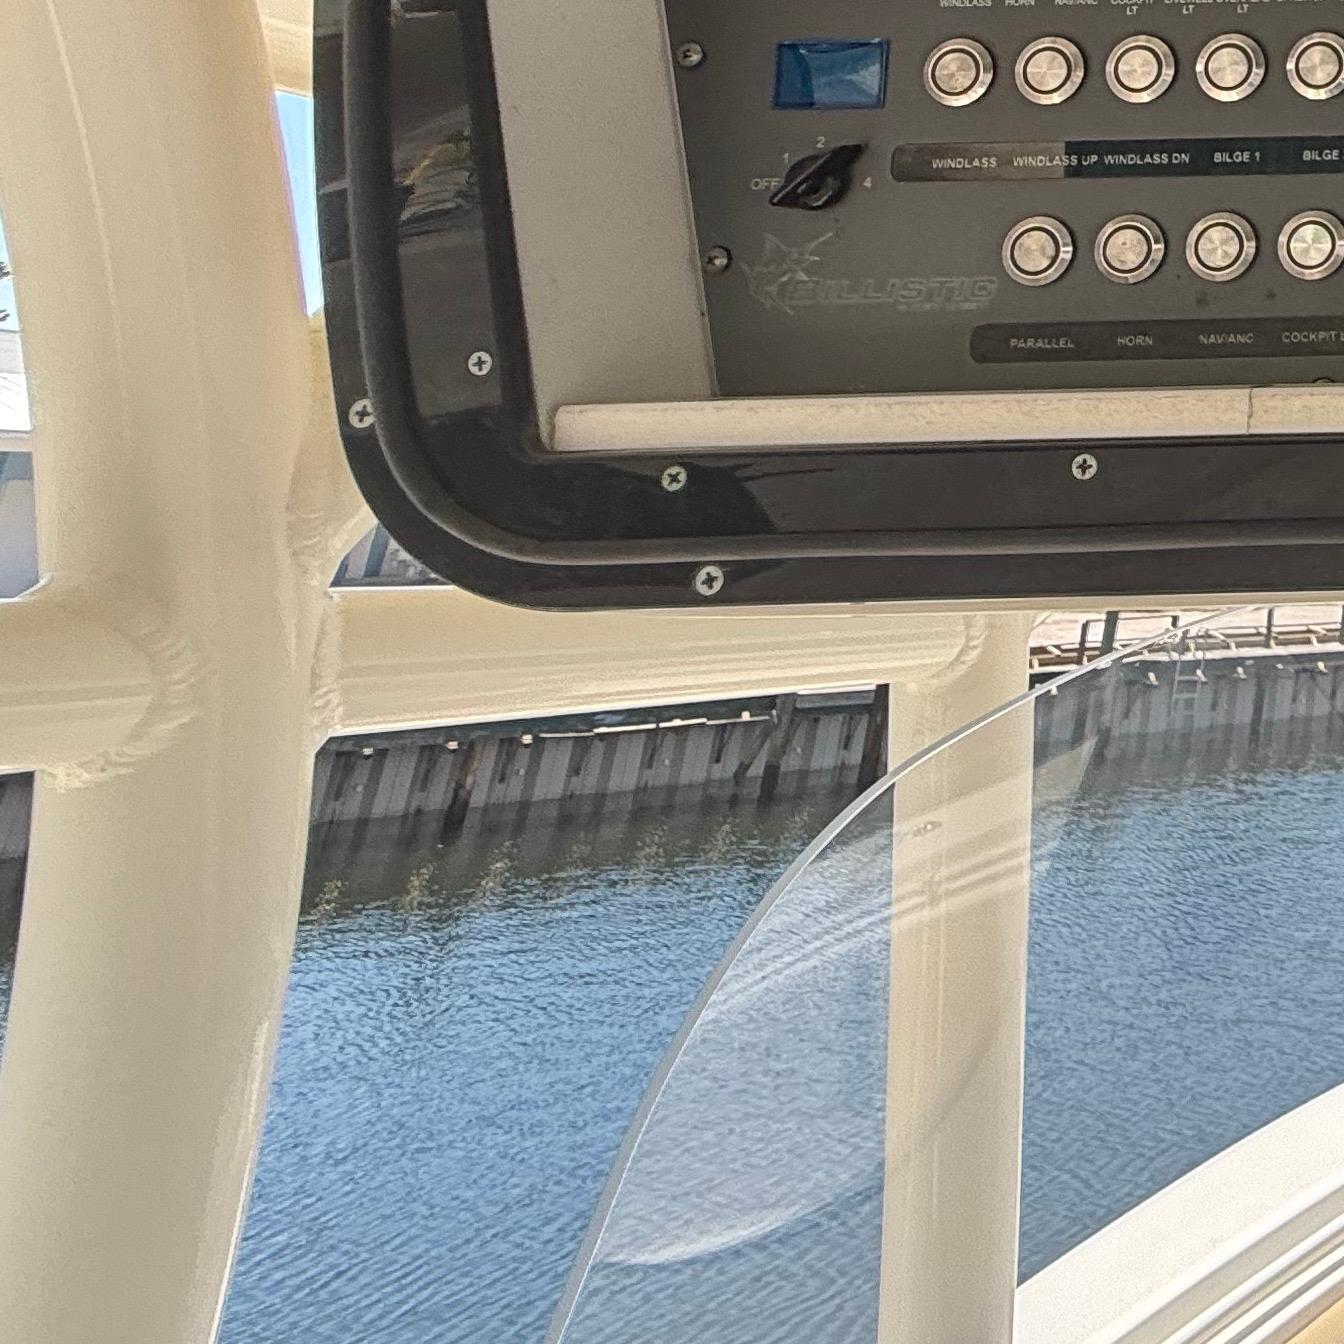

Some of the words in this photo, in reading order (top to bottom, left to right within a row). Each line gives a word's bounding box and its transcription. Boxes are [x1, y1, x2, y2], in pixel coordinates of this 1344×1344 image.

[1126, 5, 1139, 16] LT
[1182, 4, 1195, 15] LT
[1237, 3, 1249, 14] LT
[815, 136, 826, 148] 2
[1012, 155, 1078, 167] WINDLASS
[1081, 154, 1098, 166] UP
[1104, 153, 1168, 166] WINDLASS
[1171, 152, 1190, 164] DN
[1213, 151, 1250, 163] BILGE
[1254, 151, 1261, 162] 1
[1303, 150, 1339, 162] BILGE
[931, 156, 998, 169] WINDLASS
[863, 176, 872, 188] 4
[1009, 337, 1076, 349] PARALLEL
[1117, 335, 1153, 346] HORN
[1281, 331, 1337, 344] COCKPIT
